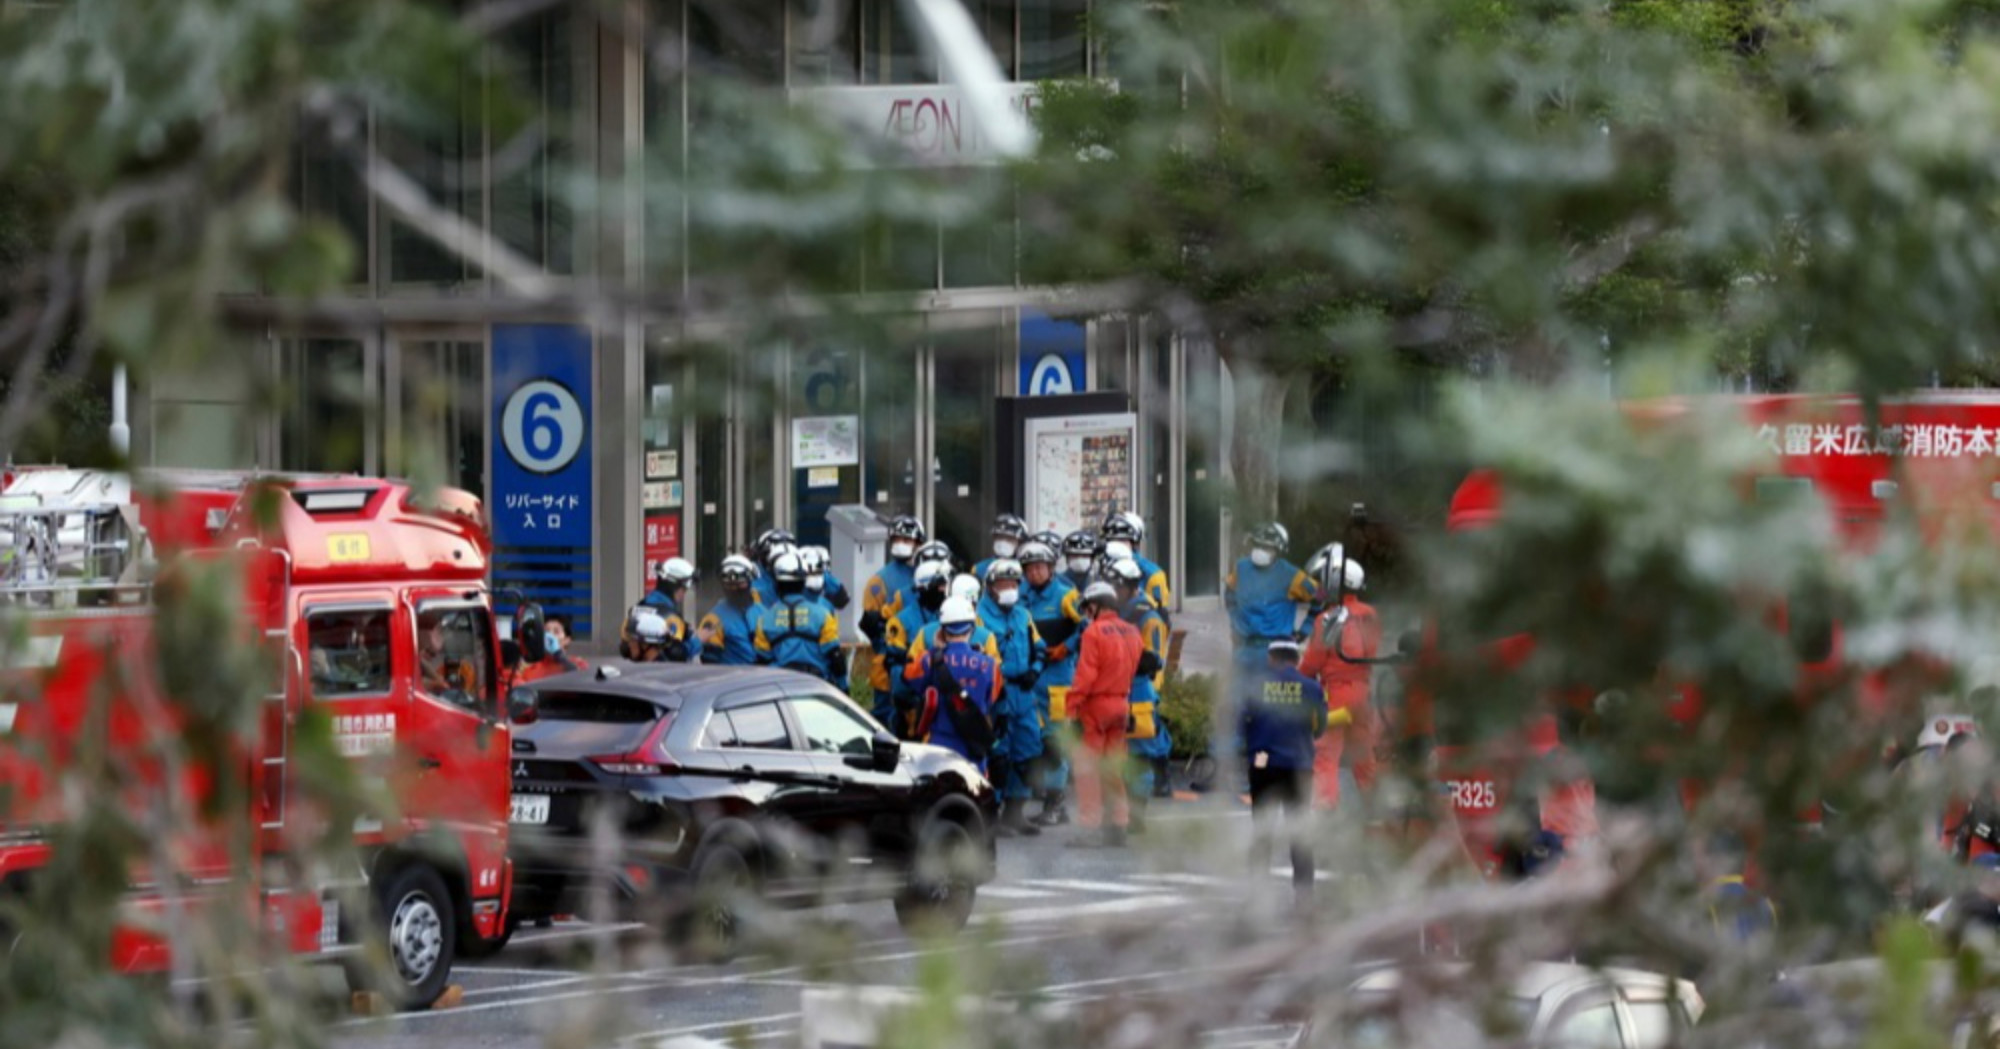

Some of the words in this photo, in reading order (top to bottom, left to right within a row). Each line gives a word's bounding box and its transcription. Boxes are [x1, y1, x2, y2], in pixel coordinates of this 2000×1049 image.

[521, 391, 563, 461] 6
[1757, 423, 2000, 456] 久留米広域消防本
[505, 494, 579, 509] リバーサイド
[523, 513, 561, 529] 入口
[1263, 681, 1303, 697] POLICE
